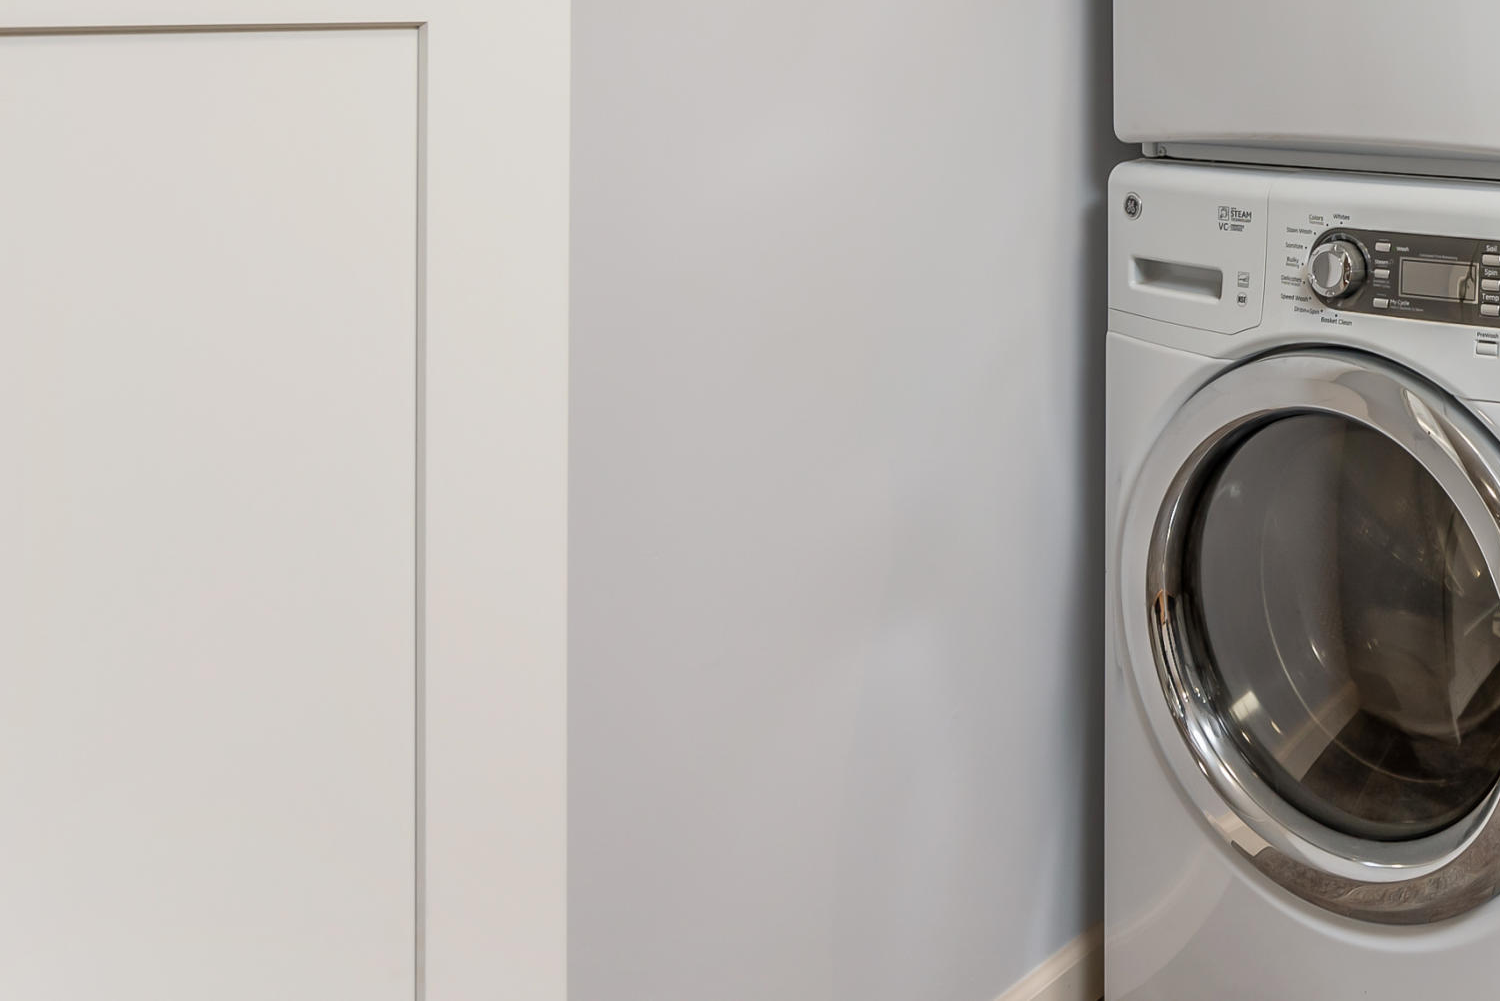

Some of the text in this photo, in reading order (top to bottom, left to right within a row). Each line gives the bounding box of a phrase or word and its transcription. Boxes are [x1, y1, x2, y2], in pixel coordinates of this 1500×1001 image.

[1230, 209, 1252, 219] STEAM
[1218, 222, 1229, 231] VC
[1484, 269, 1498, 277] Spin
[1281, 293, 1295, 301] Speed
[1482, 293, 1499, 302] Temp
